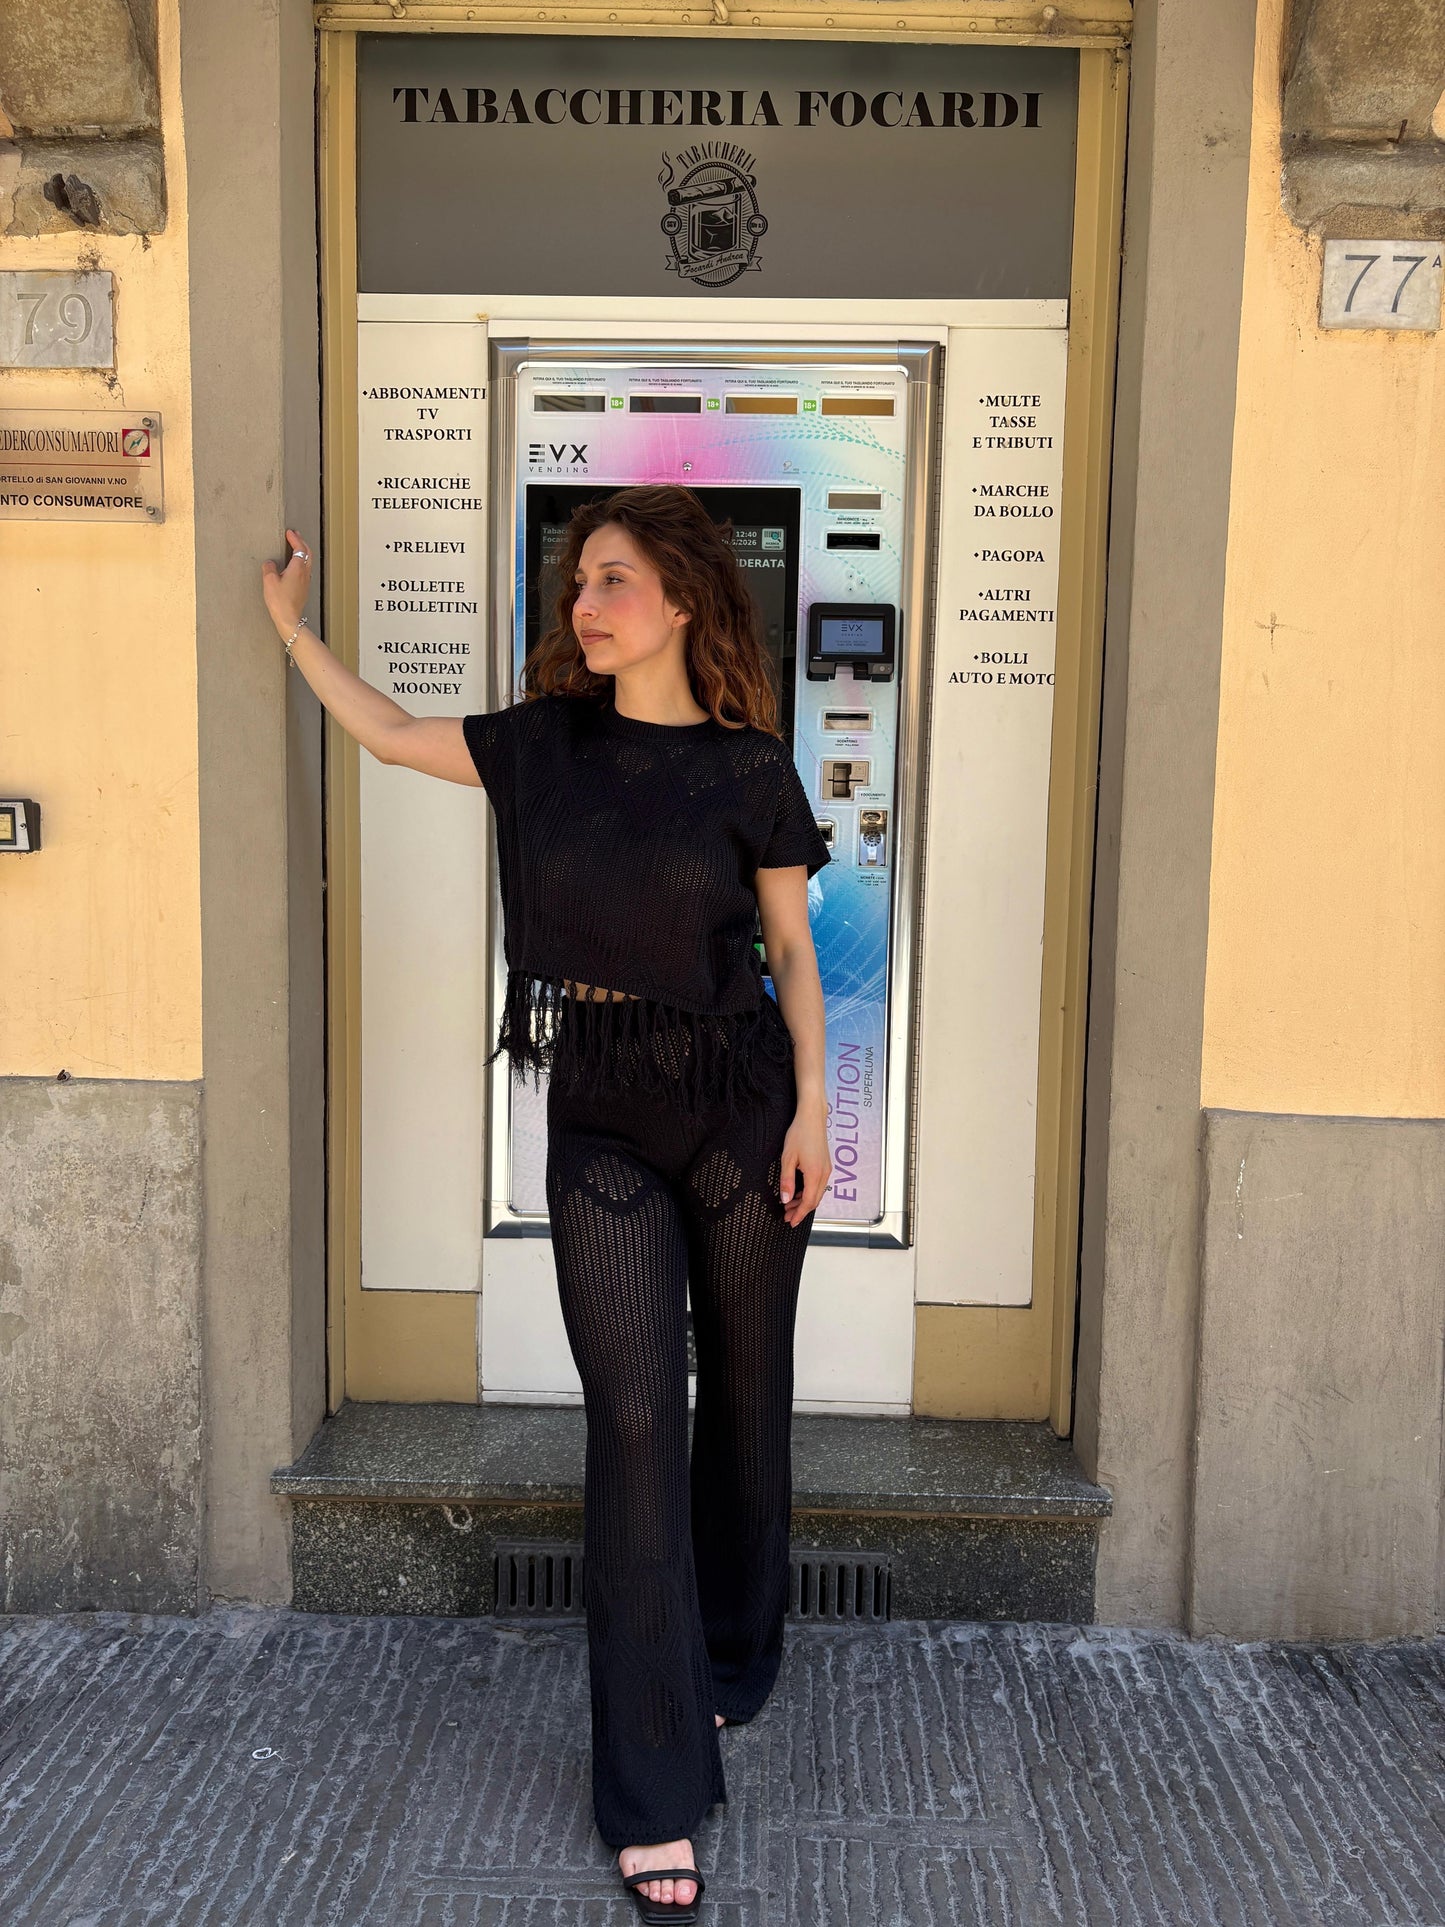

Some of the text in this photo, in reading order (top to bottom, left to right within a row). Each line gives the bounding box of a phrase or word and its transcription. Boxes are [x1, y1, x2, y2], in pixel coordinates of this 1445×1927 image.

[392, 87, 1044, 128] TABACCHERIA FOCARDI
[676, 141, 757, 172] TABACCHERIA
[683, 252, 744, 276] Focardi Andrea
[17, 292, 93, 345] 79
[369, 387, 486, 400] ABBONAMENTI
[612, 399, 623, 407] 18+
[708, 400, 720, 408] 18+
[986, 395, 1041, 408] MULTE
[416, 408, 439, 420] TV
[989, 415, 1037, 428] TASSE
[383, 428, 472, 441] TRASPORTI
[972, 436, 1053, 449] E TRIBUTI
[529, 443, 588, 464] EVX
[529, 466, 589, 474] VENDING
[0, 475, 128, 486] RTELLO di SAN GIOVANNI V.NO
[384, 477, 471, 490] RICARICHE
[980, 484, 1050, 497] MARCHE
[33, 495, 143, 508] CONSUMATORE
[371, 497, 483, 510] TELEFONICHE
[974, 505, 1054, 518] DA BOLLO
[393, 541, 465, 554] PRELIEVI
[982, 549, 1045, 563] PAGOPA
[388, 579, 465, 593] BOLLETTE
[984, 589, 1031, 602] ALTRI
[374, 599, 478, 614] E BOLLETTINI
[959, 609, 1054, 622] PAGAMENTI
[841, 624, 863, 632] EVX
[384, 641, 471, 655] RICARICHE
[981, 652, 1028, 665] BOLLI
[389, 661, 466, 675] POSTEPAY
[948, 671, 1056, 686] AUTO E MOTO
[392, 682, 462, 695] MOONEY
[863, 1046, 874, 1108] SUPERLUNA
[833, 1042, 861, 1202] EVOLUTION
